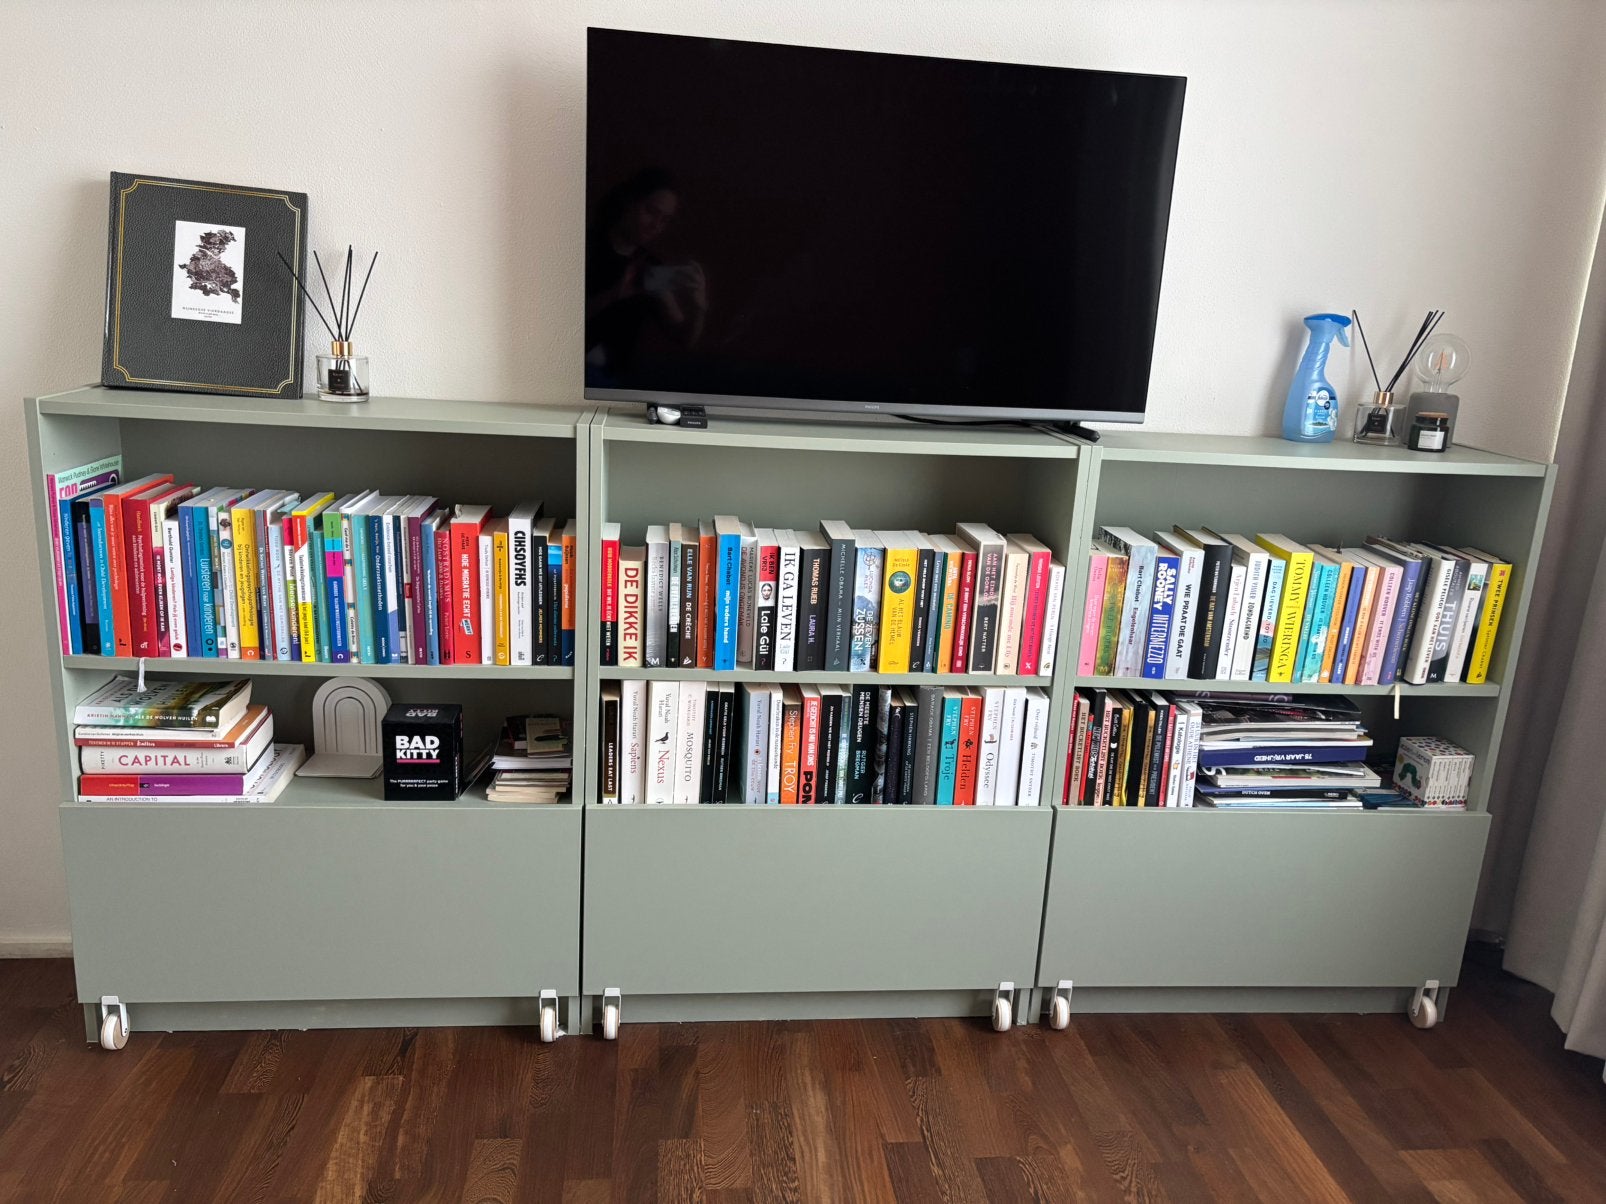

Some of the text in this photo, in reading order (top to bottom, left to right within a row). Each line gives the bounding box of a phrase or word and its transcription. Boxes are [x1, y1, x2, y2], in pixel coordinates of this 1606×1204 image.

[200, 558, 211, 591] Luisteren
[442, 538, 450, 602] NOSTRADAMUS
[461, 554, 469, 567] HOE
[514, 531, 526, 586] CIHSOYFHS
[985, 567, 991, 575] DE
[239, 580, 247, 604] jeugdigen
[375, 555, 384, 610] Onderzoeksmethoden
[462, 569, 470, 598] MIGRATIE
[780, 552, 796, 641] IK GA LEVEN
[810, 558, 820, 604] THOMAS RUEB
[1134, 580, 1142, 602] Chabot
[1153, 563, 1167, 610] ROONEY
[1165, 568, 1176, 605] SALLY
[1386, 573, 1394, 595] COLLEEN
[1401, 578, 1415, 617] Jaap Robben
[204, 603, 214, 634] kinderen
[289, 583, 299, 644] Mensenkinderen!
[463, 600, 471, 617] ECHT
[623, 567, 638, 661] DE DIKKE IK
[685, 602, 691, 611] DE
[867, 611, 873, 621] DE
[1277, 559, 1306, 668] TOMMY WIERINGA
[1488, 579, 1503, 626] TWEE PRINSEN
[759, 611, 770, 655] Lale Gül
[808, 615, 816, 645] LAURA H.
[854, 609, 865, 650] ZUSSEN
[1176, 584, 1192, 658] WIE PRAAT DIE GAAT
[1435, 600, 1456, 651] THUIS
[1147, 614, 1169, 664] INTERMEZZO
[396, 736, 440, 749] BAD
[788, 710, 797, 754] Stephen Fry
[1175, 727, 1184, 754] Katologie
[118, 755, 190, 767] CAPITAL
[396, 750, 439, 759] KITTY
[629, 743, 640, 774] Sapiens
[656, 750, 669, 783] Nexus
[684, 732, 694, 782] MOSQUITO
[942, 754, 954, 780] Troje
[984, 753, 995, 788] Odyssee
[784, 761, 796, 792] TROY
[960, 755, 971, 790] Helden
